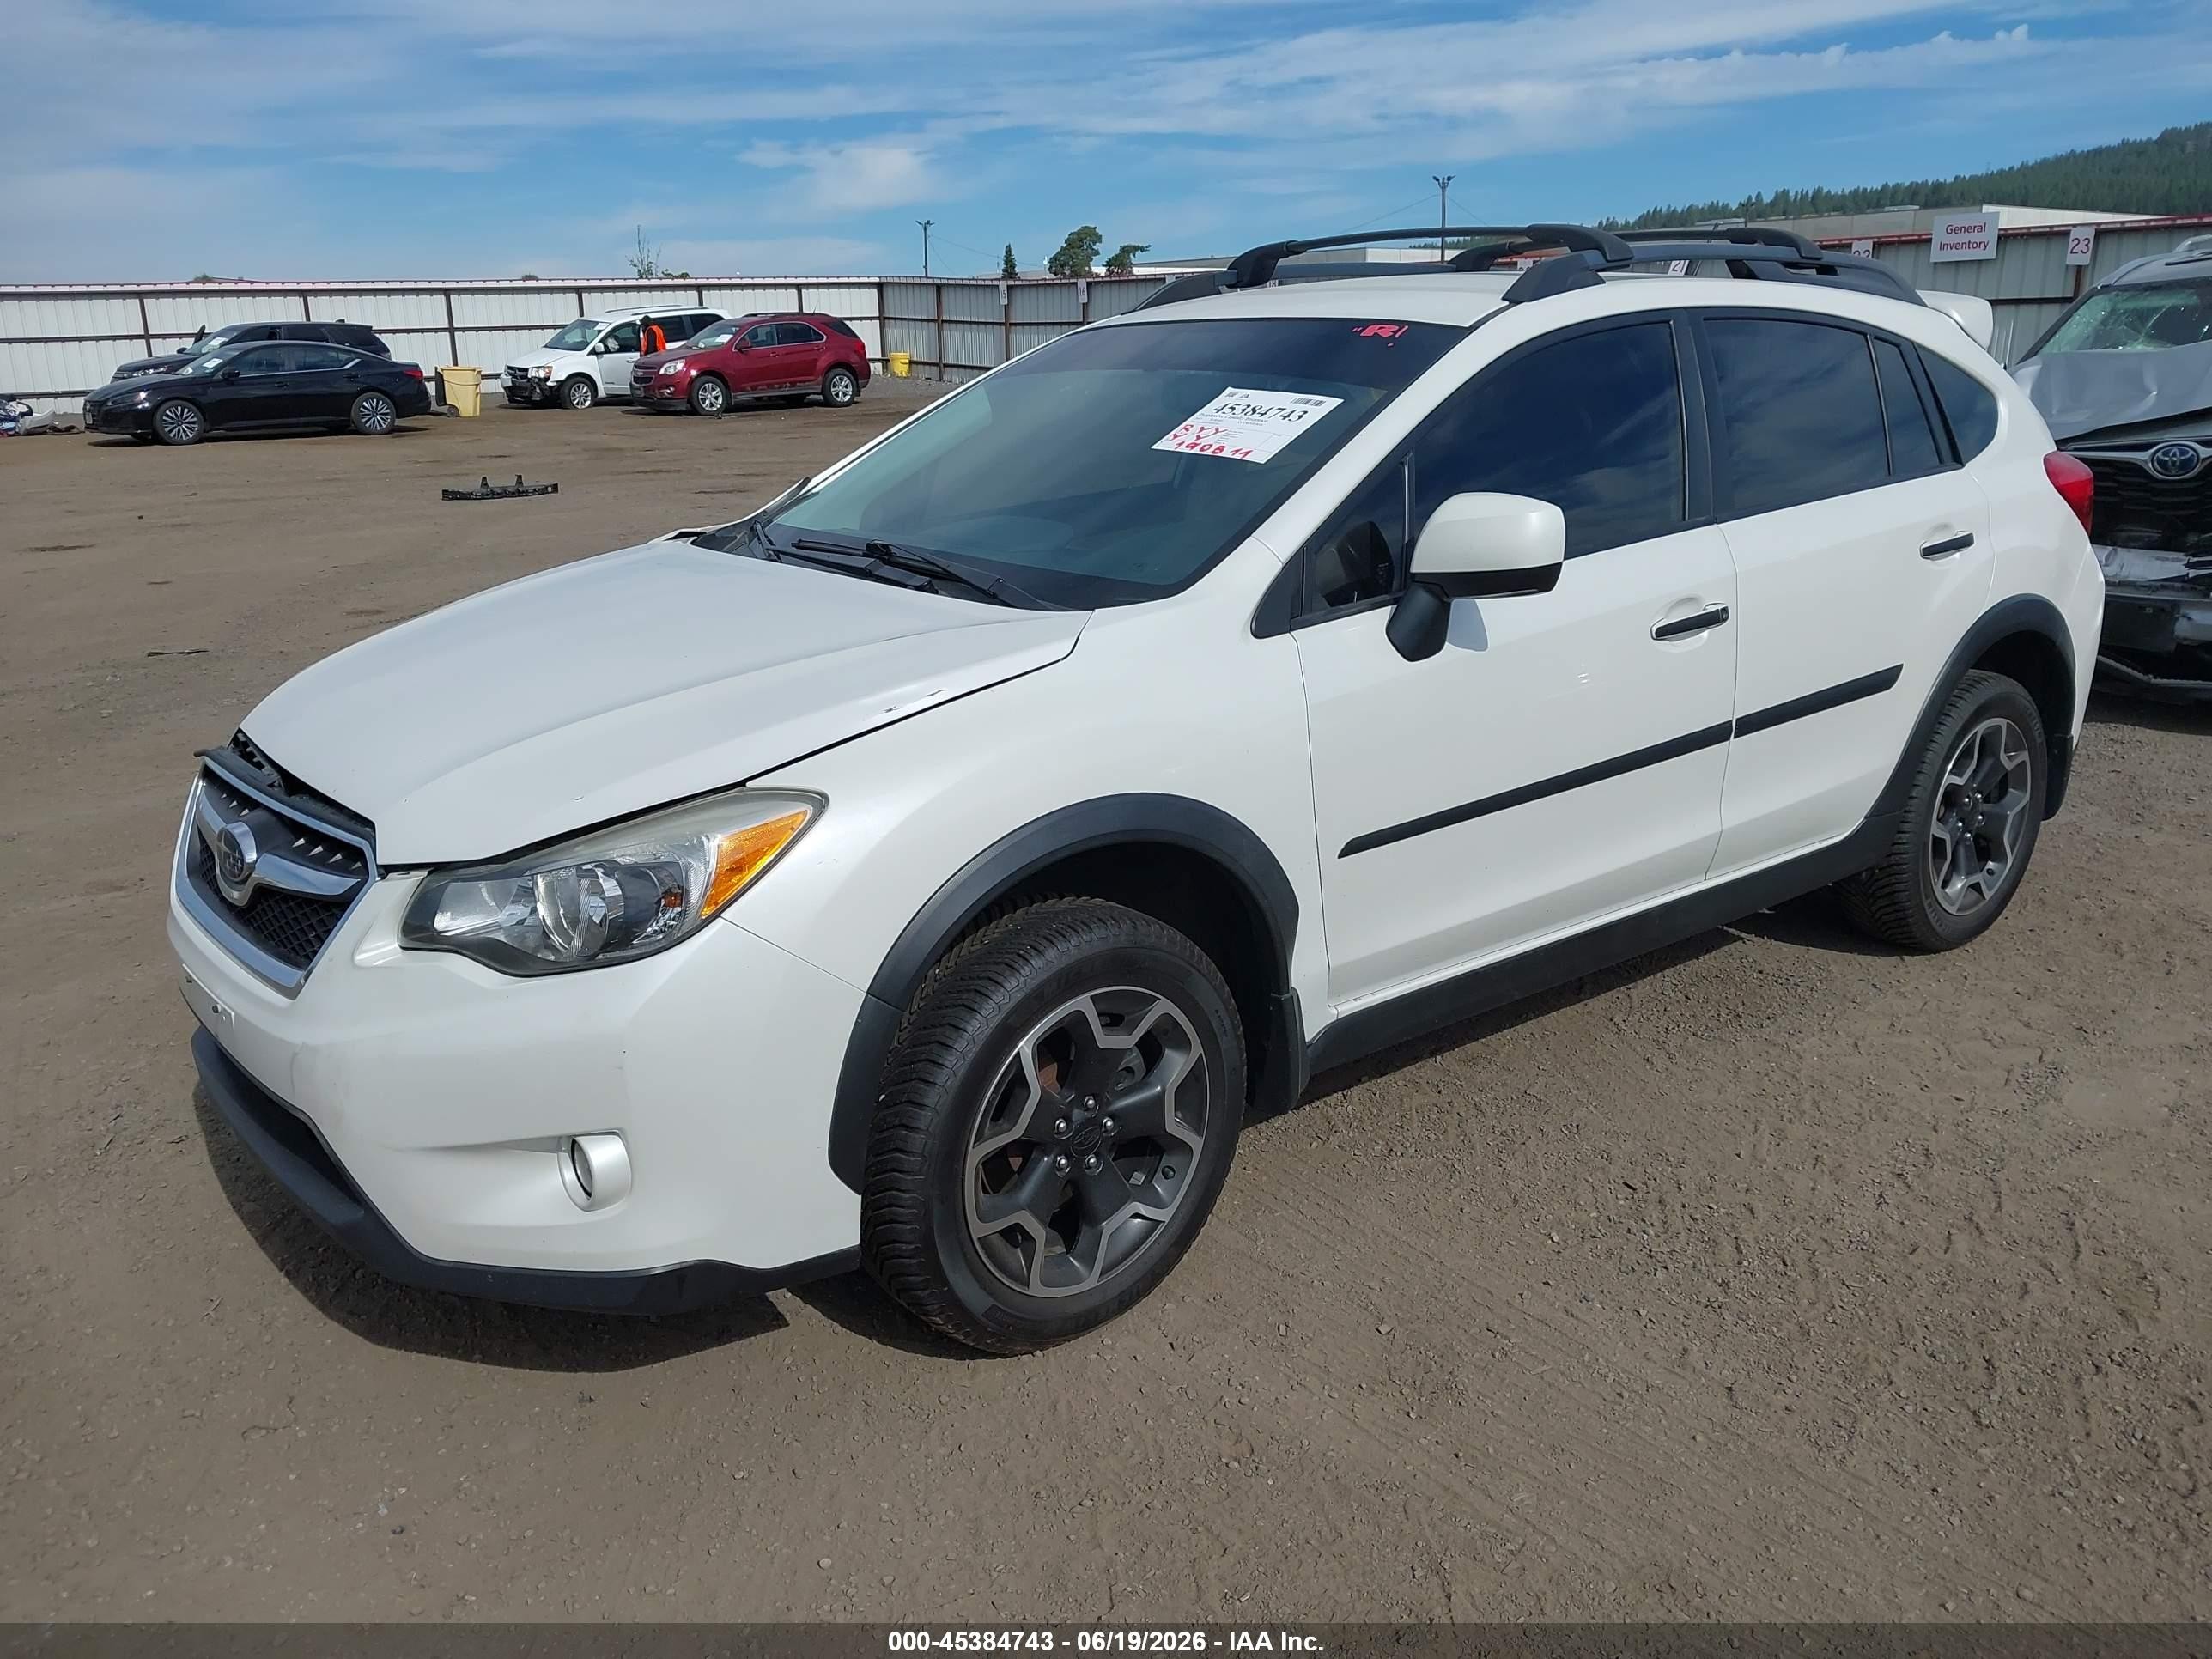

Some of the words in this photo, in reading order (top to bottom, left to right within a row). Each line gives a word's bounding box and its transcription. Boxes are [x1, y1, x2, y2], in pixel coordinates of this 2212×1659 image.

[1945, 222, 1986, 235] General
[1939, 238, 1990, 252] Inventory
[2070, 237, 2091, 255] 23
[1214, 403, 1308, 422] 45384743
